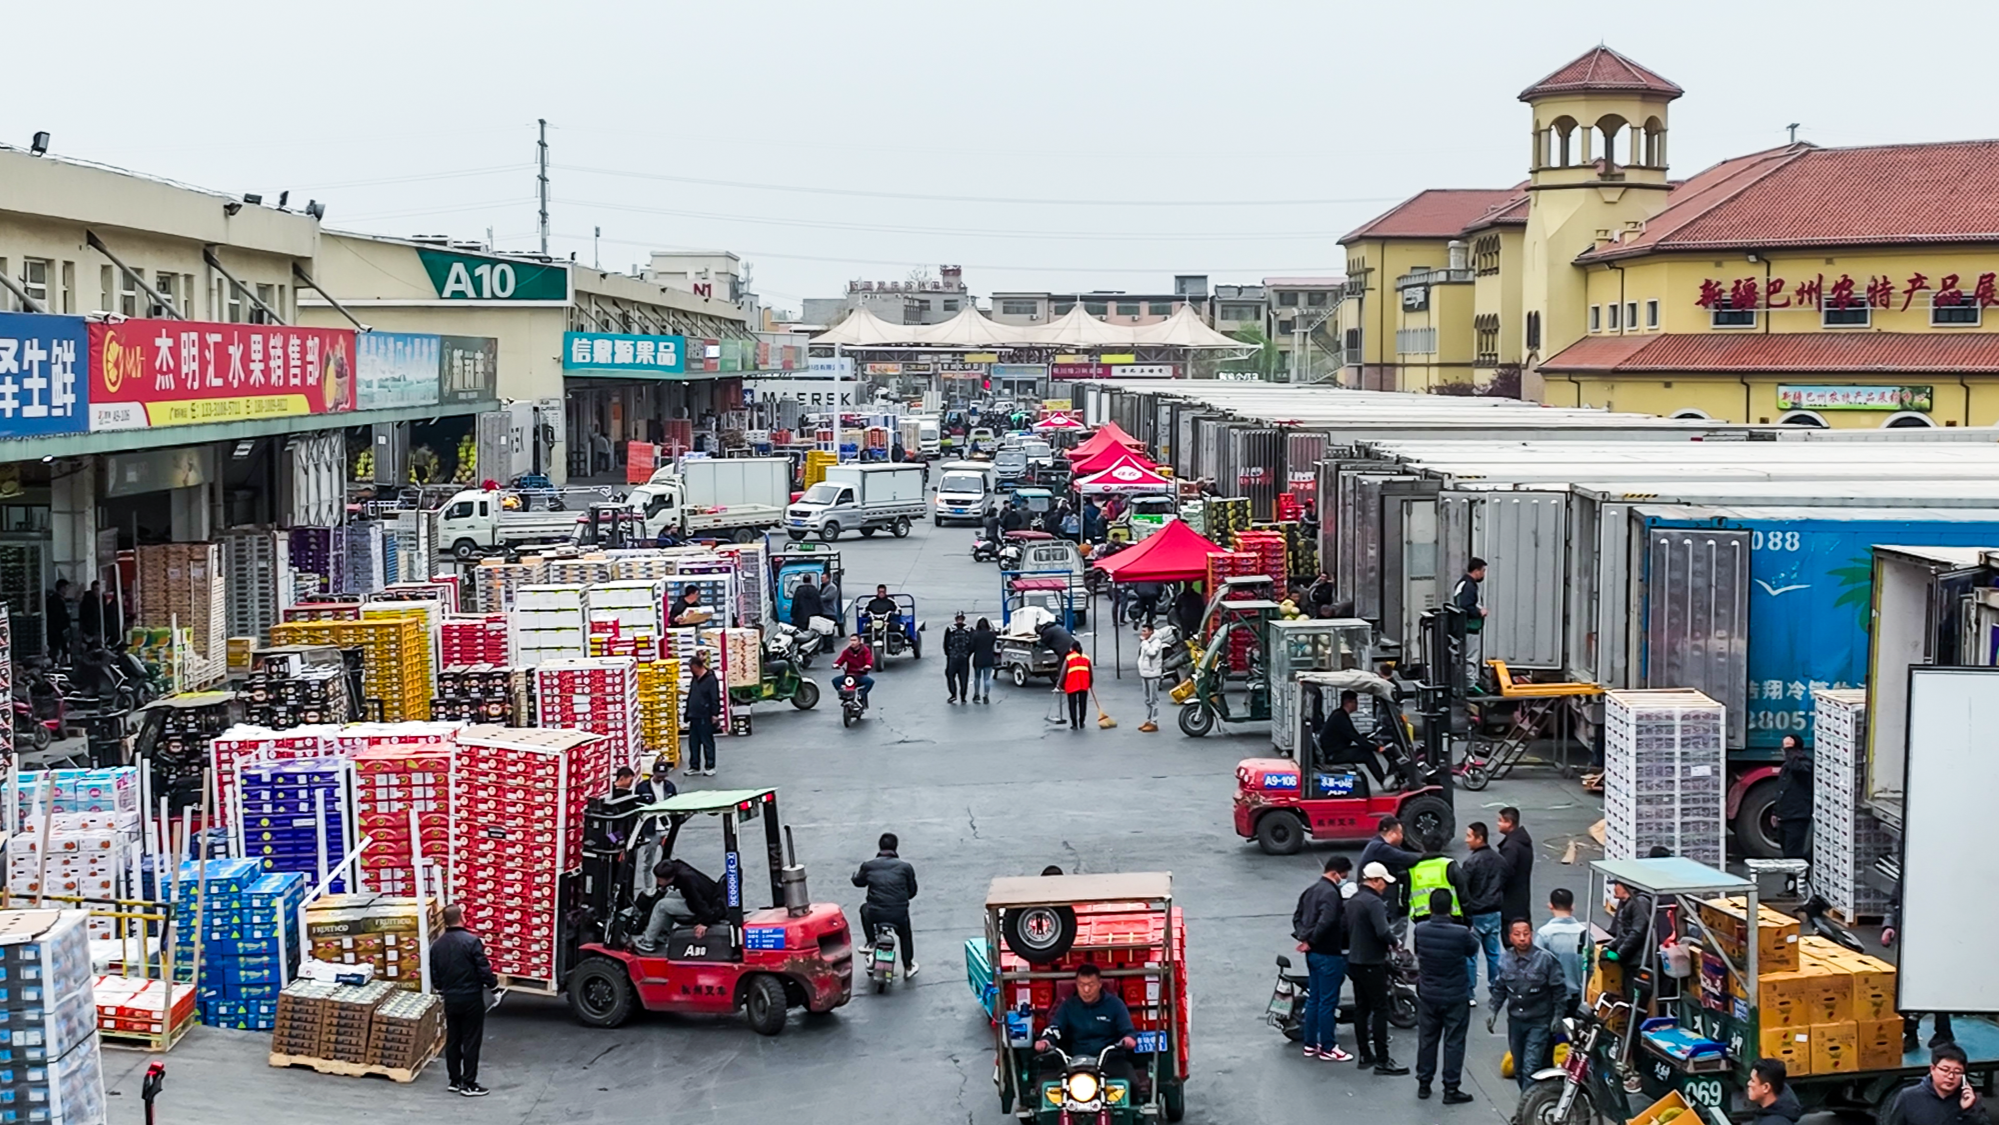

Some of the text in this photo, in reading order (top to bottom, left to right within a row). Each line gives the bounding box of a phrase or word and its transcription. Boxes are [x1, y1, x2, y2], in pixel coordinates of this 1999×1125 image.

[441, 262, 516, 298] A10
[693, 283, 711, 298] N1
[155, 328, 320, 391] 杰明汇水果销售部
[763, 391, 851, 406] MERSK
[1264, 775, 1298, 787] A9-106
[1685, 1080, 1723, 1107] 069
